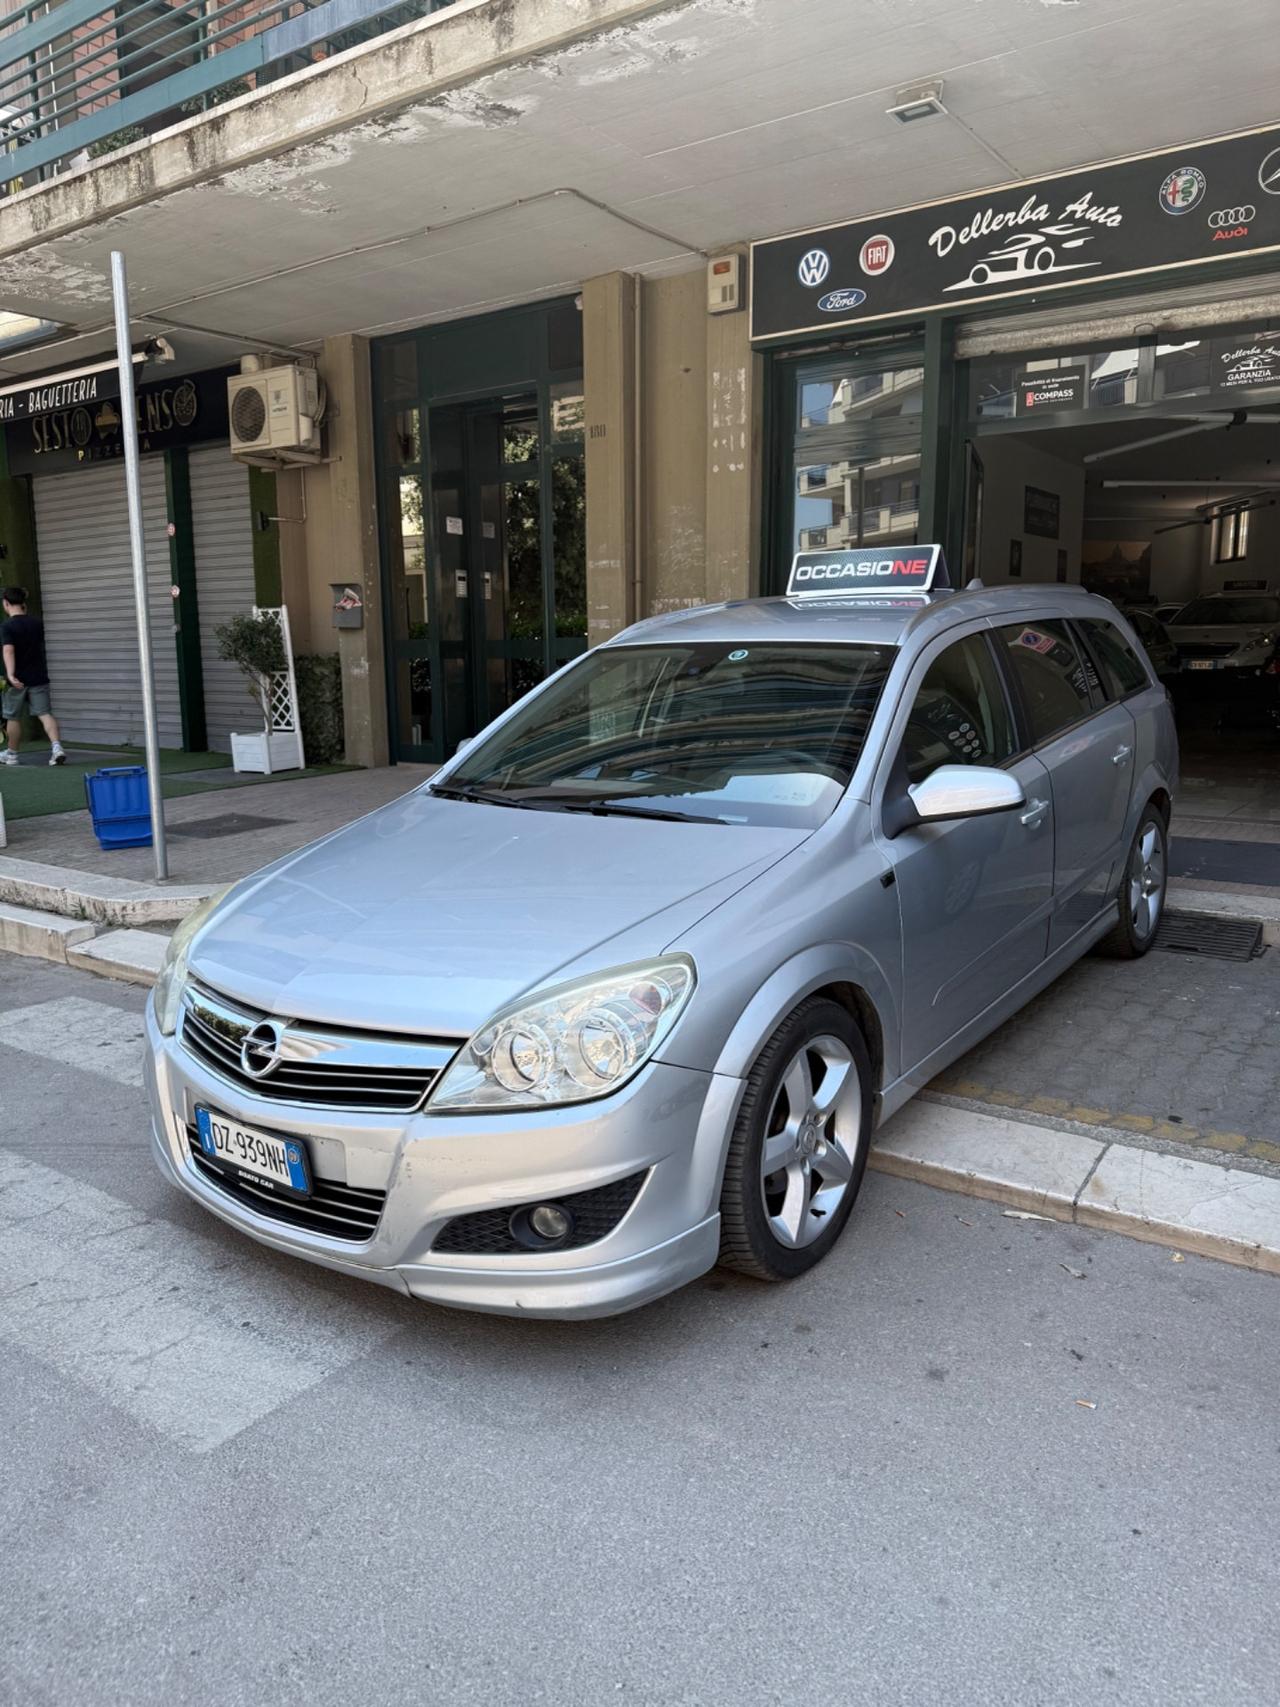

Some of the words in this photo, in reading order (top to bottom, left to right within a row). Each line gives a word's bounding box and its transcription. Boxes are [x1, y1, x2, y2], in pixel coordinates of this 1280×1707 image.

[1180, 169, 1204, 189] ROMEO
[928, 194, 1051, 258] Dellerba
[1058, 191, 1123, 227] Auto
[1213, 227, 1248, 241] Audi
[867, 245, 888, 266] FIAT
[826, 292, 858, 309] Ford
[1227, 369, 1272, 381] GARANZIA
[28, 377, 97, 413] BAGUETTERIA
[1034, 388, 1074, 401] COMPASS
[32, 407, 93, 454] SESTO
[796, 560, 928, 580] OCCASIONE
